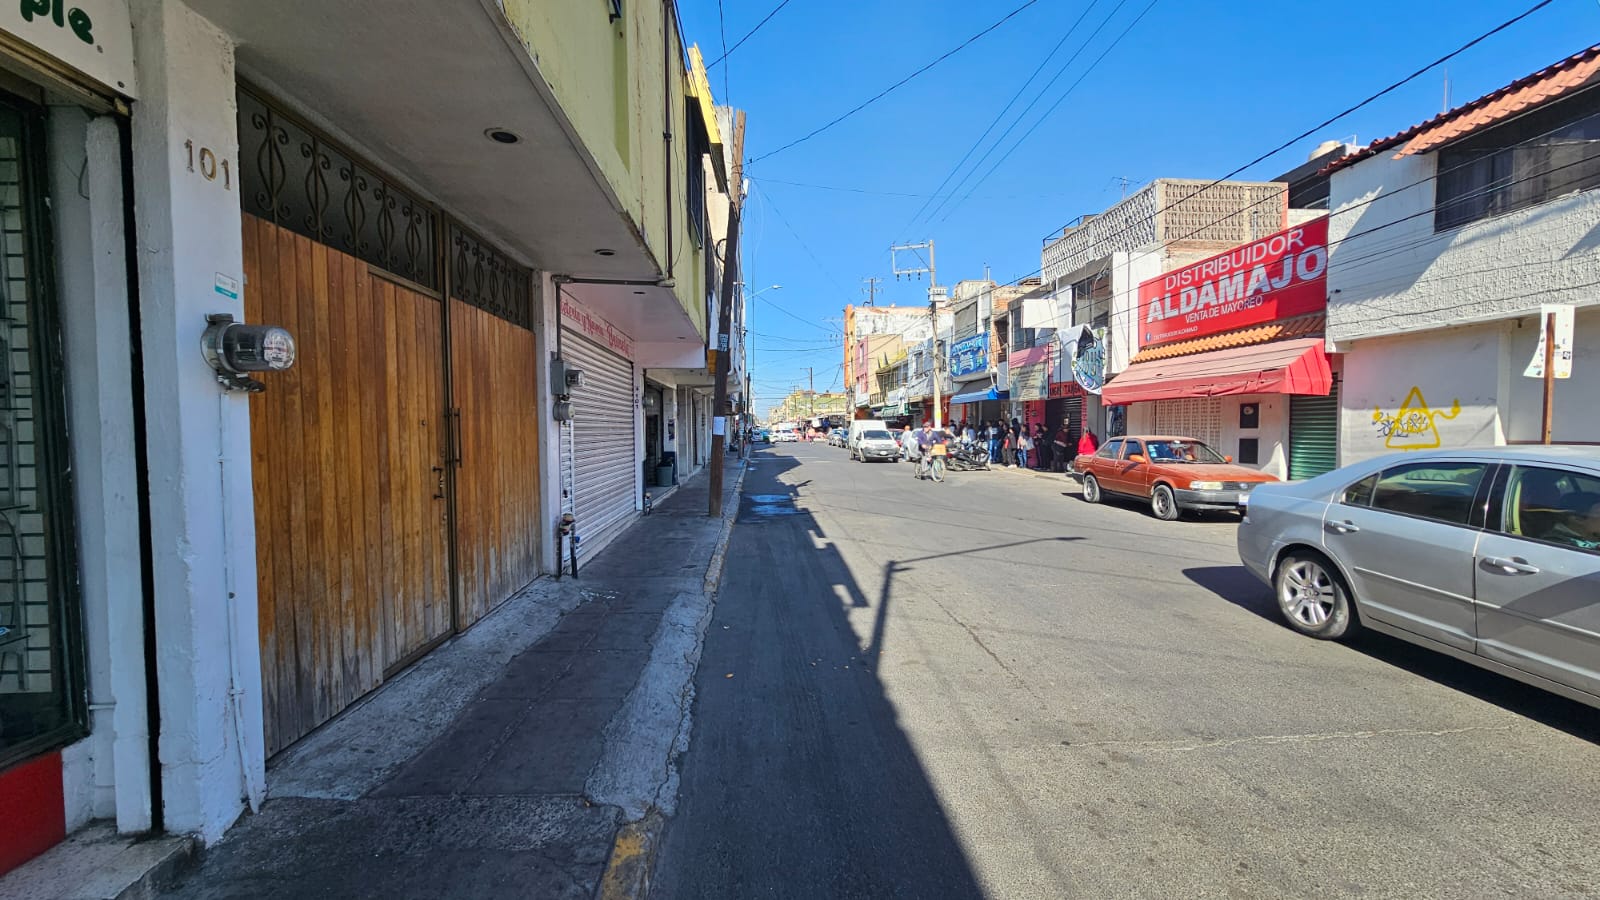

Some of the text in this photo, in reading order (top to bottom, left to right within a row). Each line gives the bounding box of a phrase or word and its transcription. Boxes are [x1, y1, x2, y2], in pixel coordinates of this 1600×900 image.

[184, 138, 232, 191] 101
[1147, 244, 1328, 323] ALDAMAJO
[1165, 228, 1304, 291] DISTRIBUIDOR
[1185, 295, 1263, 324] VENTA DE MAYOREO
